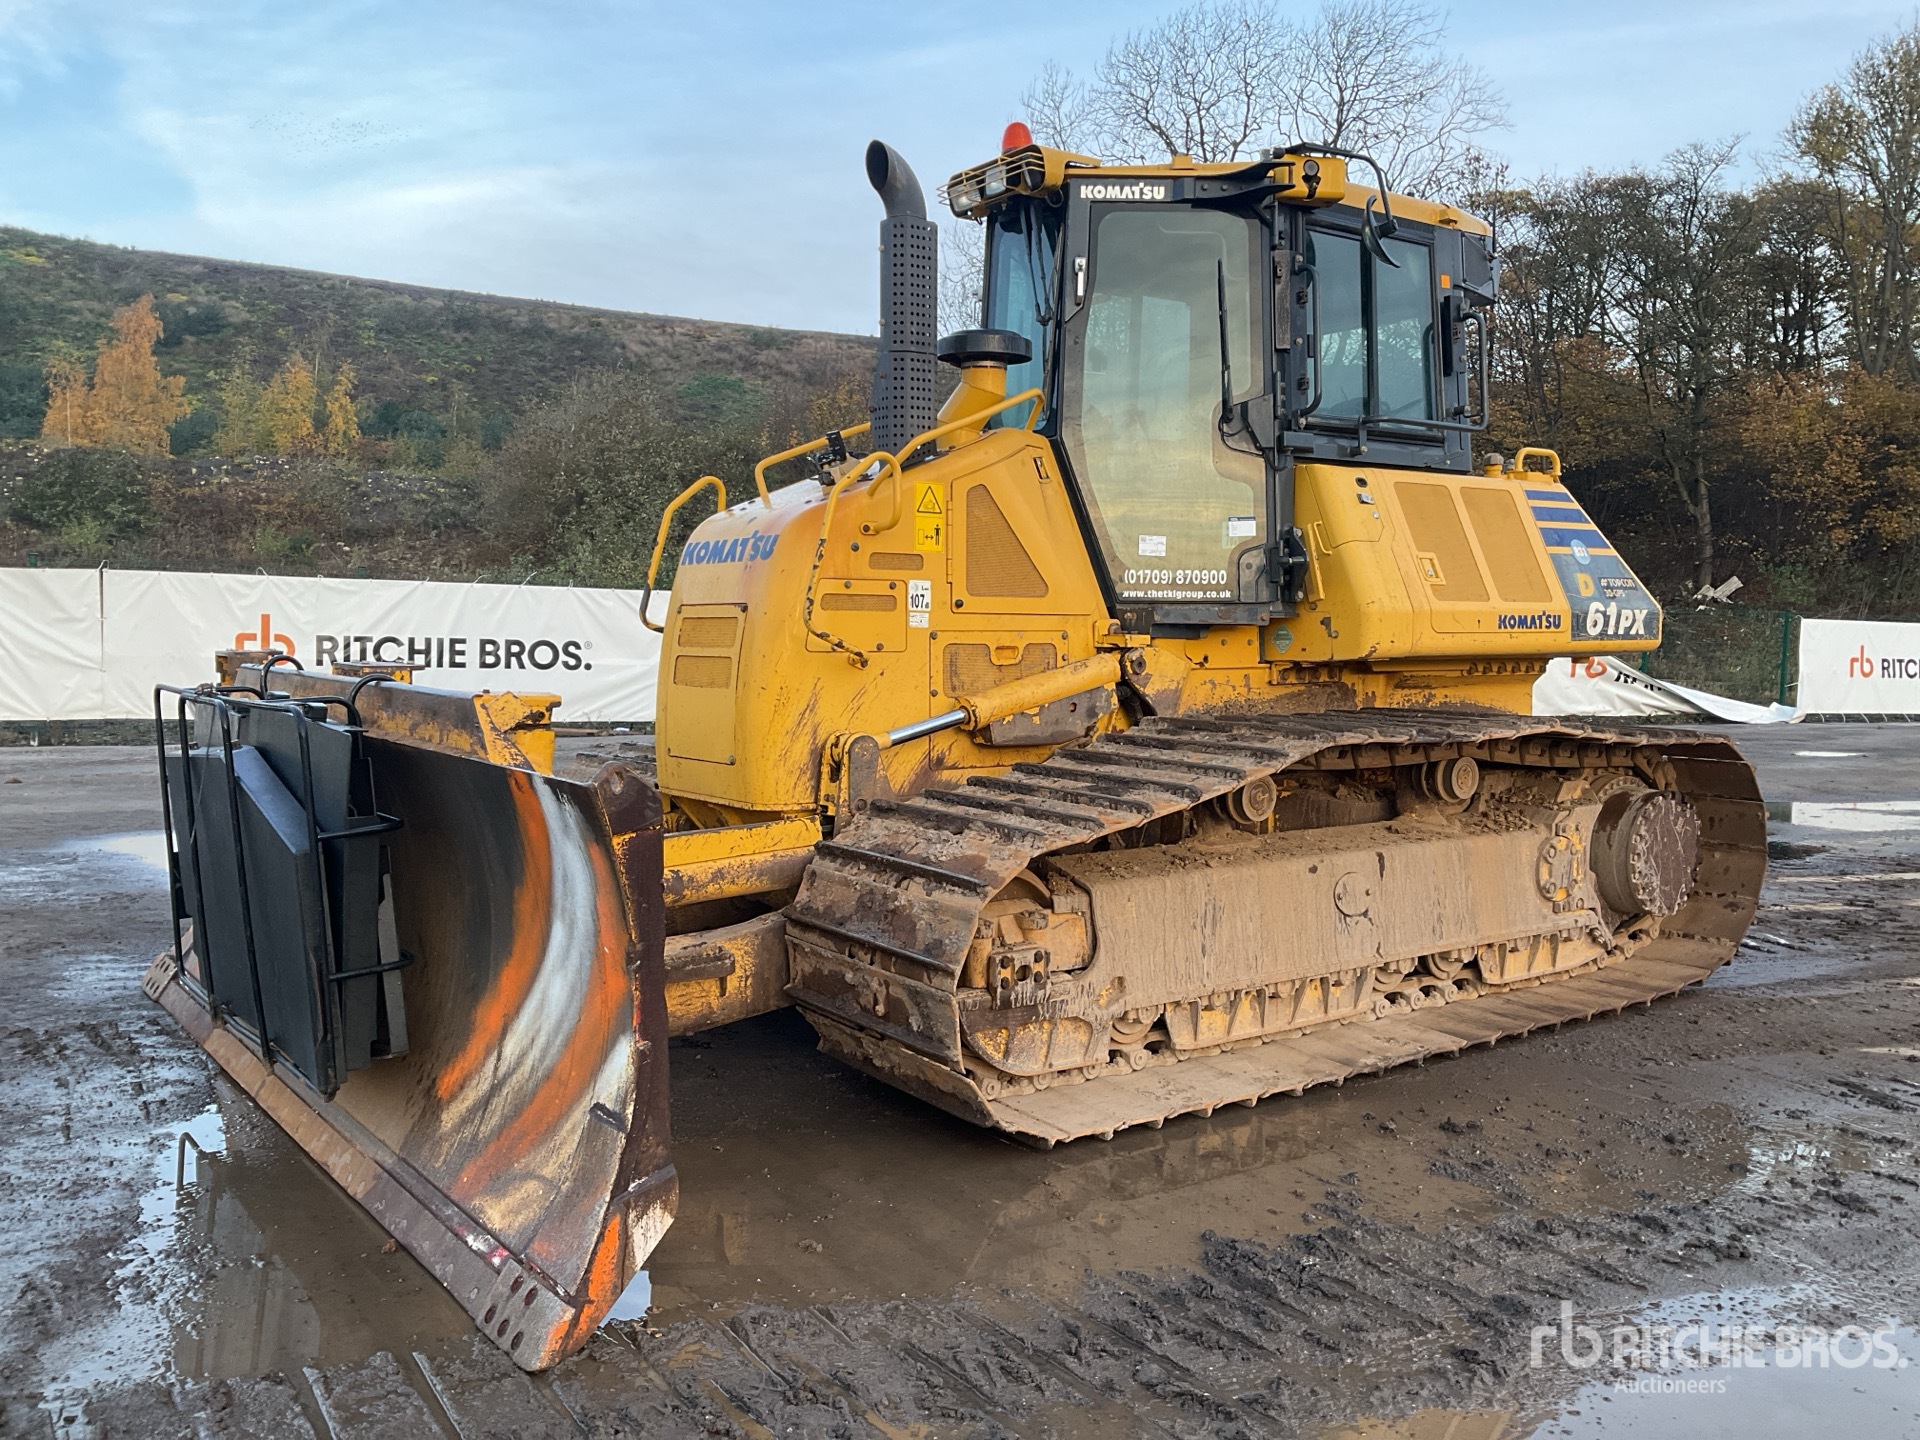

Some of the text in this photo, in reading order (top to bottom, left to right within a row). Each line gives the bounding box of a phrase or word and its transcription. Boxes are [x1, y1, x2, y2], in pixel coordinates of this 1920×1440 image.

[1080, 182, 1165, 200] KOMATSU
[681, 530, 779, 566] KOMATSU
[1124, 569, 1227, 585] (01709) 870900
[1577, 573, 1595, 597] D
[910, 593, 925, 609] 107
[1498, 610, 1562, 630] KOMATSU
[315, 634, 468, 669] RITCHIE
[1881, 658, 1920, 679] RITC
